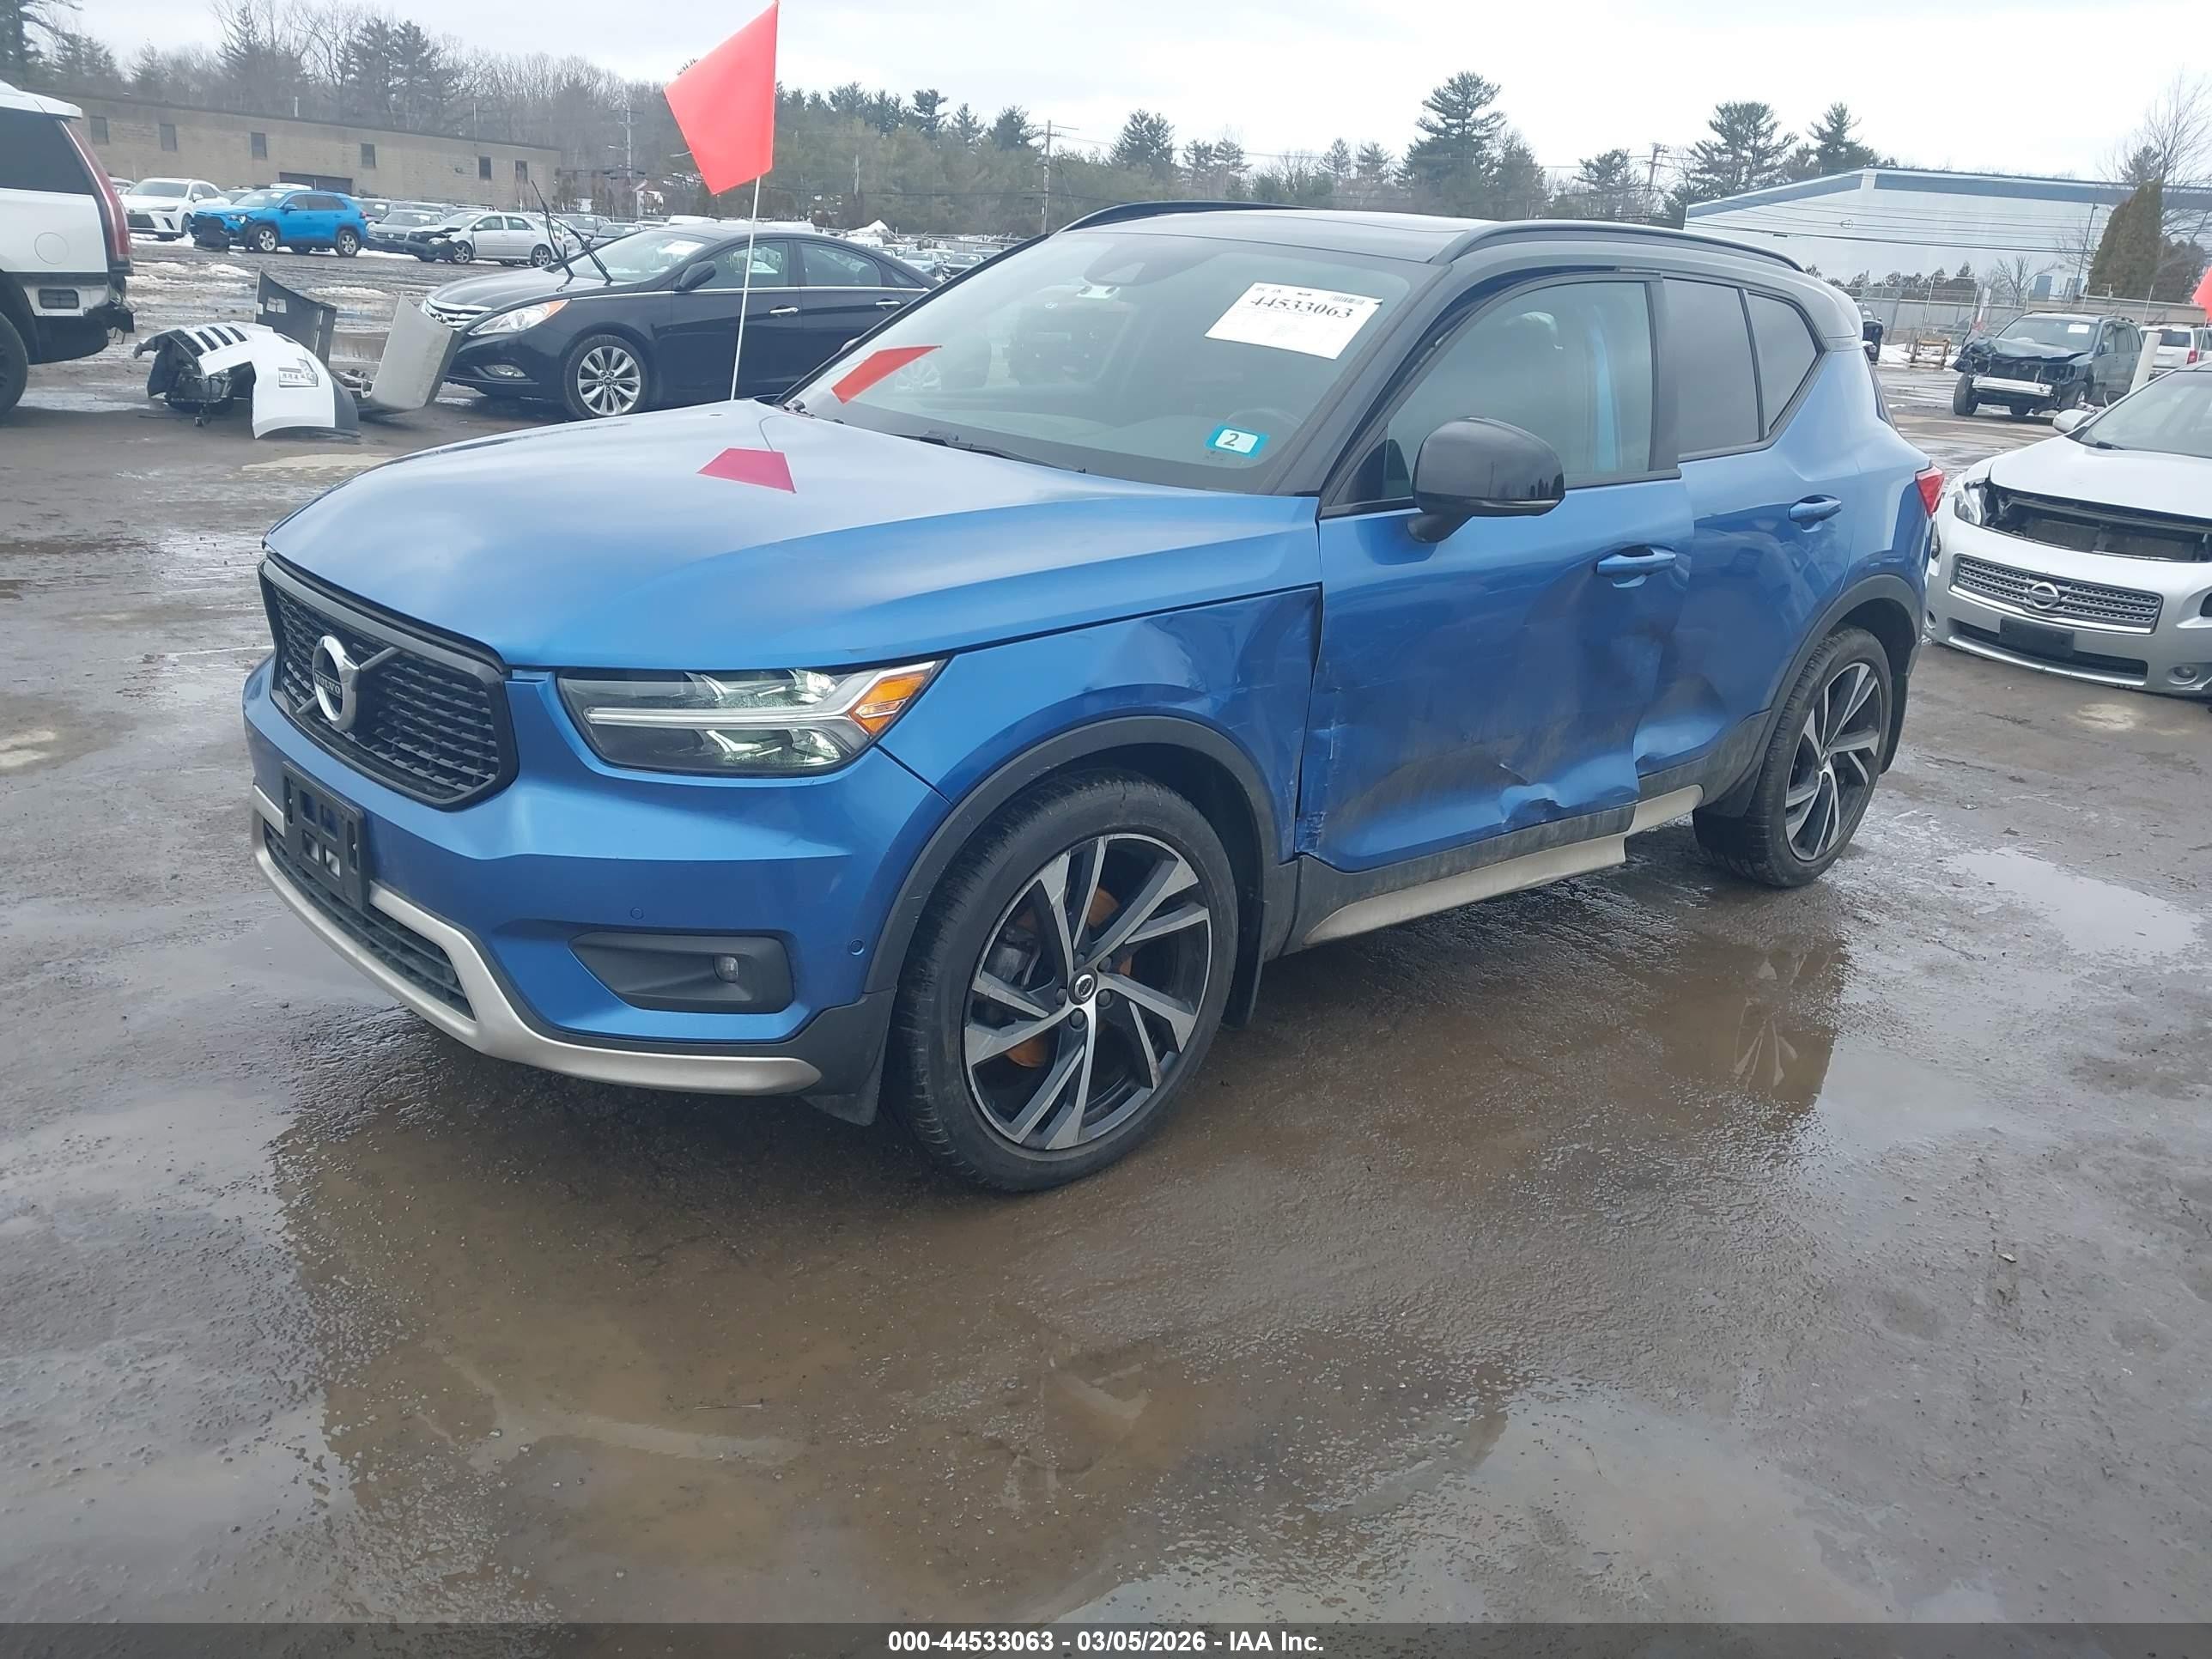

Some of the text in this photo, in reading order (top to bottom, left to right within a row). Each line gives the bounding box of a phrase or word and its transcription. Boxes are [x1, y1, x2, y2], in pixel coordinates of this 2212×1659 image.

[1249, 295, 1353, 319] 44533063
[1223, 432, 1240, 447] 2
[314, 672, 342, 695] VOLVO
